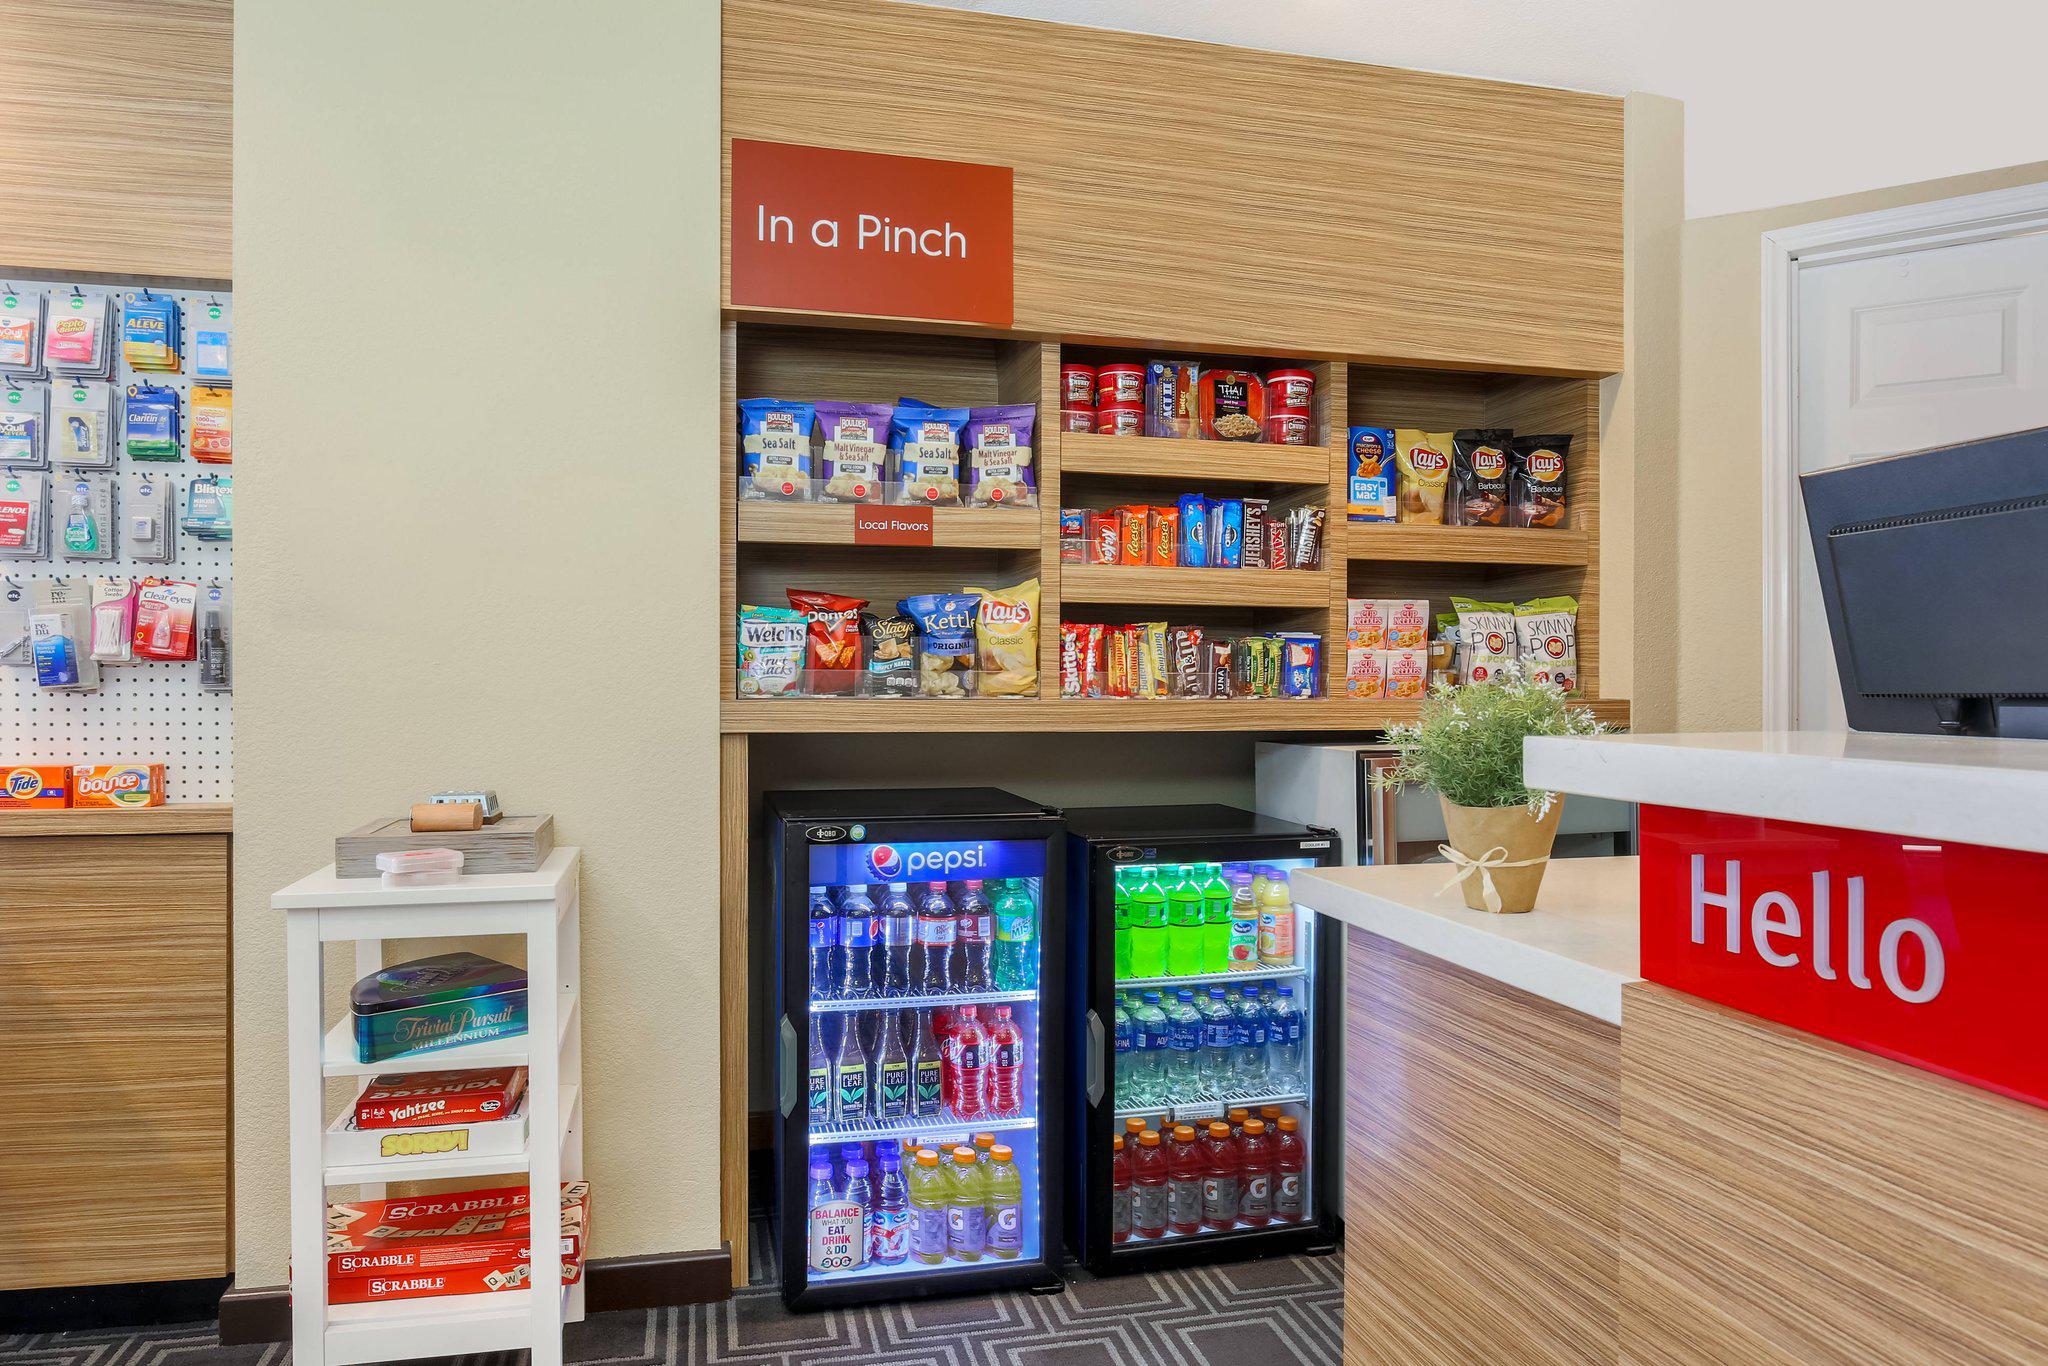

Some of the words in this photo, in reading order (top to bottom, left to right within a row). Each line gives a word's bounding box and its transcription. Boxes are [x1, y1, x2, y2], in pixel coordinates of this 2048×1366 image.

[758, 204, 794, 244] In
[811, 218, 838, 248] a
[858, 213, 967, 259] Pinch
[126, 317, 165, 330] ALEVE
[1163, 382, 1172, 396] II
[1218, 384, 1243, 397] THAI
[1291, 386, 1309, 394] CHUNKY
[1163, 397, 1172, 419] ACT
[128, 413, 158, 423] Claritin
[767, 413, 792, 424] BOULDER
[841, 418, 867, 431] BOULDER
[924, 422, 949, 432] BOULDER
[984, 425, 1009, 436] BOULDER
[762, 438, 778, 449] Sea
[779, 437, 796, 450] Salt
[834, 443, 848, 453] Malt
[849, 443, 875, 456] Vinegar
[844, 453, 858, 462] Sea
[858, 453, 870, 462] Salt
[919, 447, 934, 459] Sea
[935, 447, 952, 460] Salt
[978, 450, 992, 459] Malt
[993, 449, 1017, 461] Vinegar
[1413, 448, 1445, 470] Lay's
[989, 458, 1001, 466] Sea
[1001, 457, 1013, 465] Salt
[1475, 451, 1504, 470] Lay's
[1531, 456, 1561, 473] Lay's
[194, 483, 232, 496] Blistex
[1354, 482, 1378, 492] Easy
[1478, 482, 1505, 491] Barbecue
[1530, 484, 1563, 494] Barbecue
[1356, 491, 1377, 501] Mac
[859, 519, 888, 531] Local
[891, 520, 929, 532] Flavors
[100, 513, 108, 555] personal
[1126, 518, 1139, 558] Reese's
[1157, 520, 1169, 559] Reese's
[1196, 521, 1204, 545] OREO
[1224, 524, 1232, 548] OREO
[1245, 507, 1262, 564] HERSHEY'S
[1272, 531, 1288, 569] TWIX
[143, 590, 168, 601] Clear
[984, 600, 1028, 625] Lay's
[1360, 610, 1378, 618] CUP
[1401, 610, 1418, 618] CUP
[1353, 617, 1384, 626] NOODLES
[1393, 617, 1424, 626] NOODLES
[1468, 615, 1512, 632] SKINNY
[1527, 616, 1575, 638] SKINNY
[745, 623, 804, 643] Welch's
[873, 619, 915, 639] Stacy's
[989, 635, 1025, 646] Classic
[1471, 631, 1516, 655] POP
[1530, 634, 1576, 660] POP
[1062, 629, 1080, 693] Skittles
[1154, 631, 1168, 680] Butterfinger
[894, 660, 911, 669] NAKED
[1360, 660, 1377, 668] CUP
[1400, 660, 1417, 668] CUP
[1352, 667, 1382, 676] NOODLES
[1391, 667, 1422, 676] NOODLES
[9, 775, 39, 795] Tide
[80, 774, 139, 796] bounce
[907, 844, 984, 876] pepsi
[1012, 924, 1031, 936] MIS
[1690, 853, 1946, 1004] Hello
[393, 1015, 456, 1043] Trivial
[451, 1004, 516, 1038] Pursuit
[411, 1026, 501, 1051] MILLENNIUM
[810, 1076, 825, 1085] URE
[842, 1073, 862, 1081] PURE
[886, 1071, 905, 1079] PURE
[920, 1070, 938, 1078] PURE
[369, 1078, 504, 1100] Yahtzee
[388, 1099, 446, 1124] Yahtzee
[1250, 1178, 1267, 1199] G
[387, 1193, 527, 1220] SCRABBLE
[815, 1207, 859, 1220] BALANCE
[822, 1219, 839, 1227] WHAT
[841, 1217, 854, 1225] YOU
[828, 1225, 846, 1236] EAT
[822, 1235, 851, 1246] DRINK
[825, 1246, 833, 1255] &
[834, 1244, 848, 1255] DO
[340, 1253, 416, 1271] SCRABBLE
[370, 1276, 446, 1295] SCRABBLE
